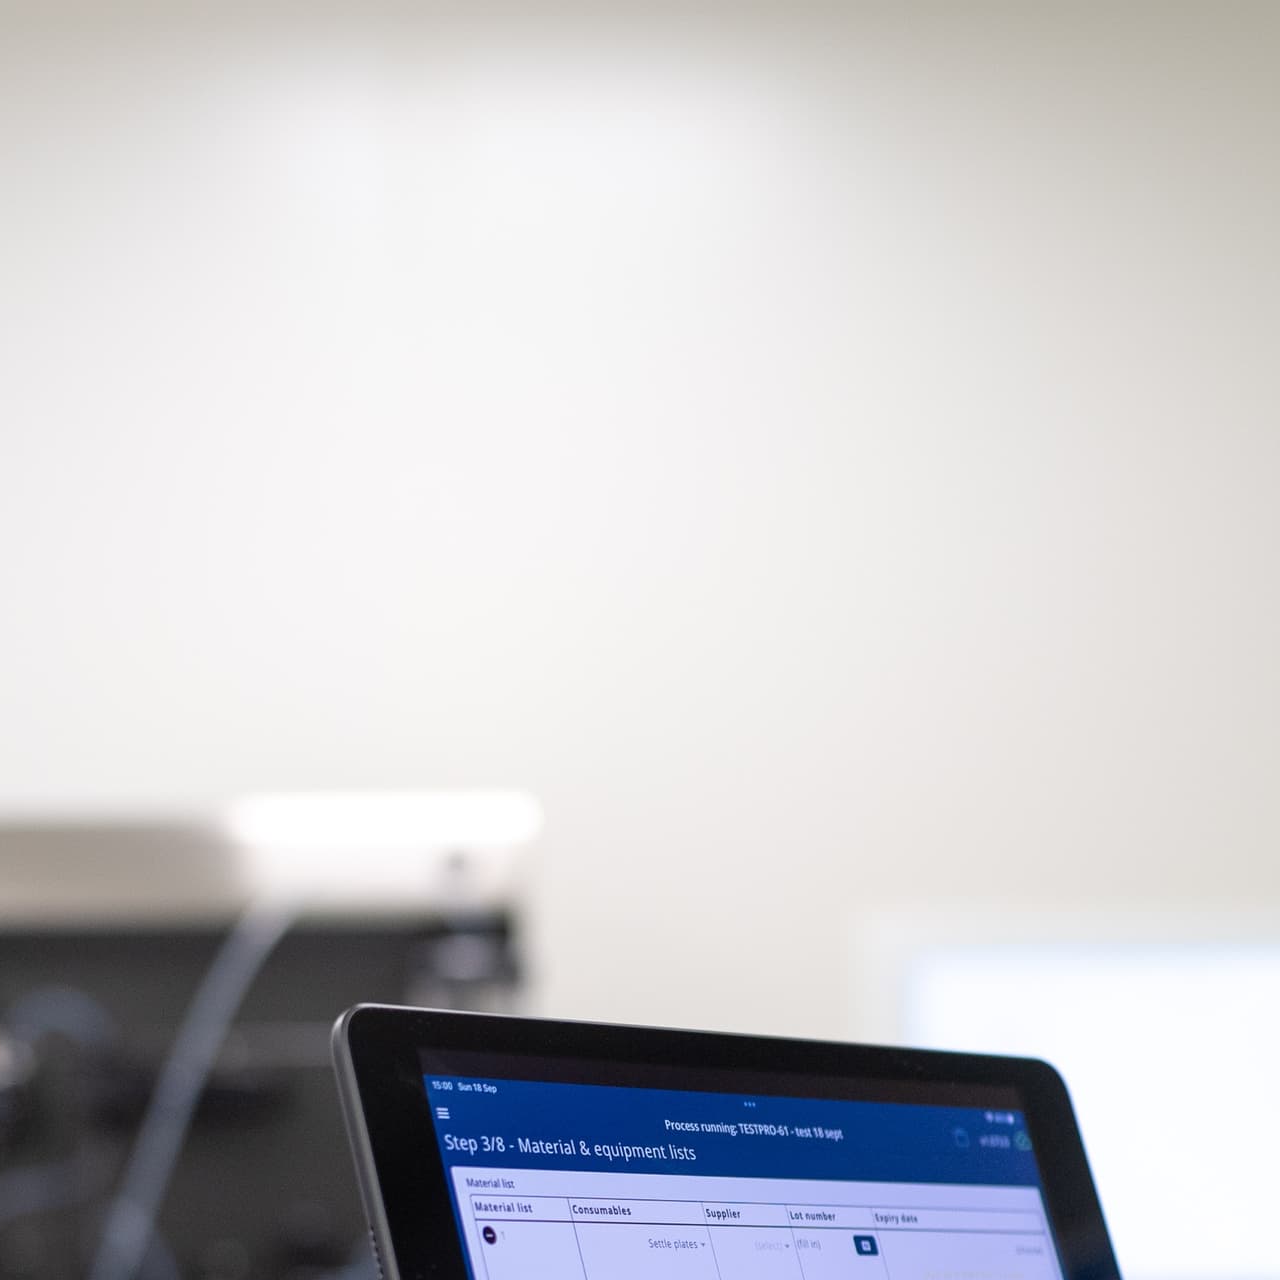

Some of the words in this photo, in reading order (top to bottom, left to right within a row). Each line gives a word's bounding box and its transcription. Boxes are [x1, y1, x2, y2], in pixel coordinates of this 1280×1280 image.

[457, 1082, 472, 1092] Sun
[474, 1083, 482, 1092] 18
[483, 1084, 497, 1094] Sep
[664, 1119, 700, 1132] Process
[701, 1122, 737, 1137] running:
[738, 1123, 789, 1137] TESTPRO-61
[795, 1127, 812, 1138] test
[815, 1127, 823, 1138] 18
[824, 1129, 843, 1141] sept
[444, 1134, 478, 1156] Step
[481, 1136, 506, 1152] 3/8
[519, 1138, 576, 1155] Material
[579, 1141, 591, 1156] &
[594, 1143, 667, 1162] equipment
[670, 1145, 696, 1161] lists
[466, 1177, 500, 1189] Material
[502, 1178, 515, 1189] list
[474, 1202, 517, 1214] Material
[520, 1203, 533, 1214] list
[572, 1204, 632, 1216] Consumables
[705, 1208, 741, 1220] Supplier
[789, 1211, 803, 1221] Lot
[805, 1211, 836, 1222] number
[874, 1212, 899, 1225] Expiry
[901, 1214, 918, 1223] date
[648, 1239, 672, 1249] Settle
[674, 1239, 698, 1250] plates
